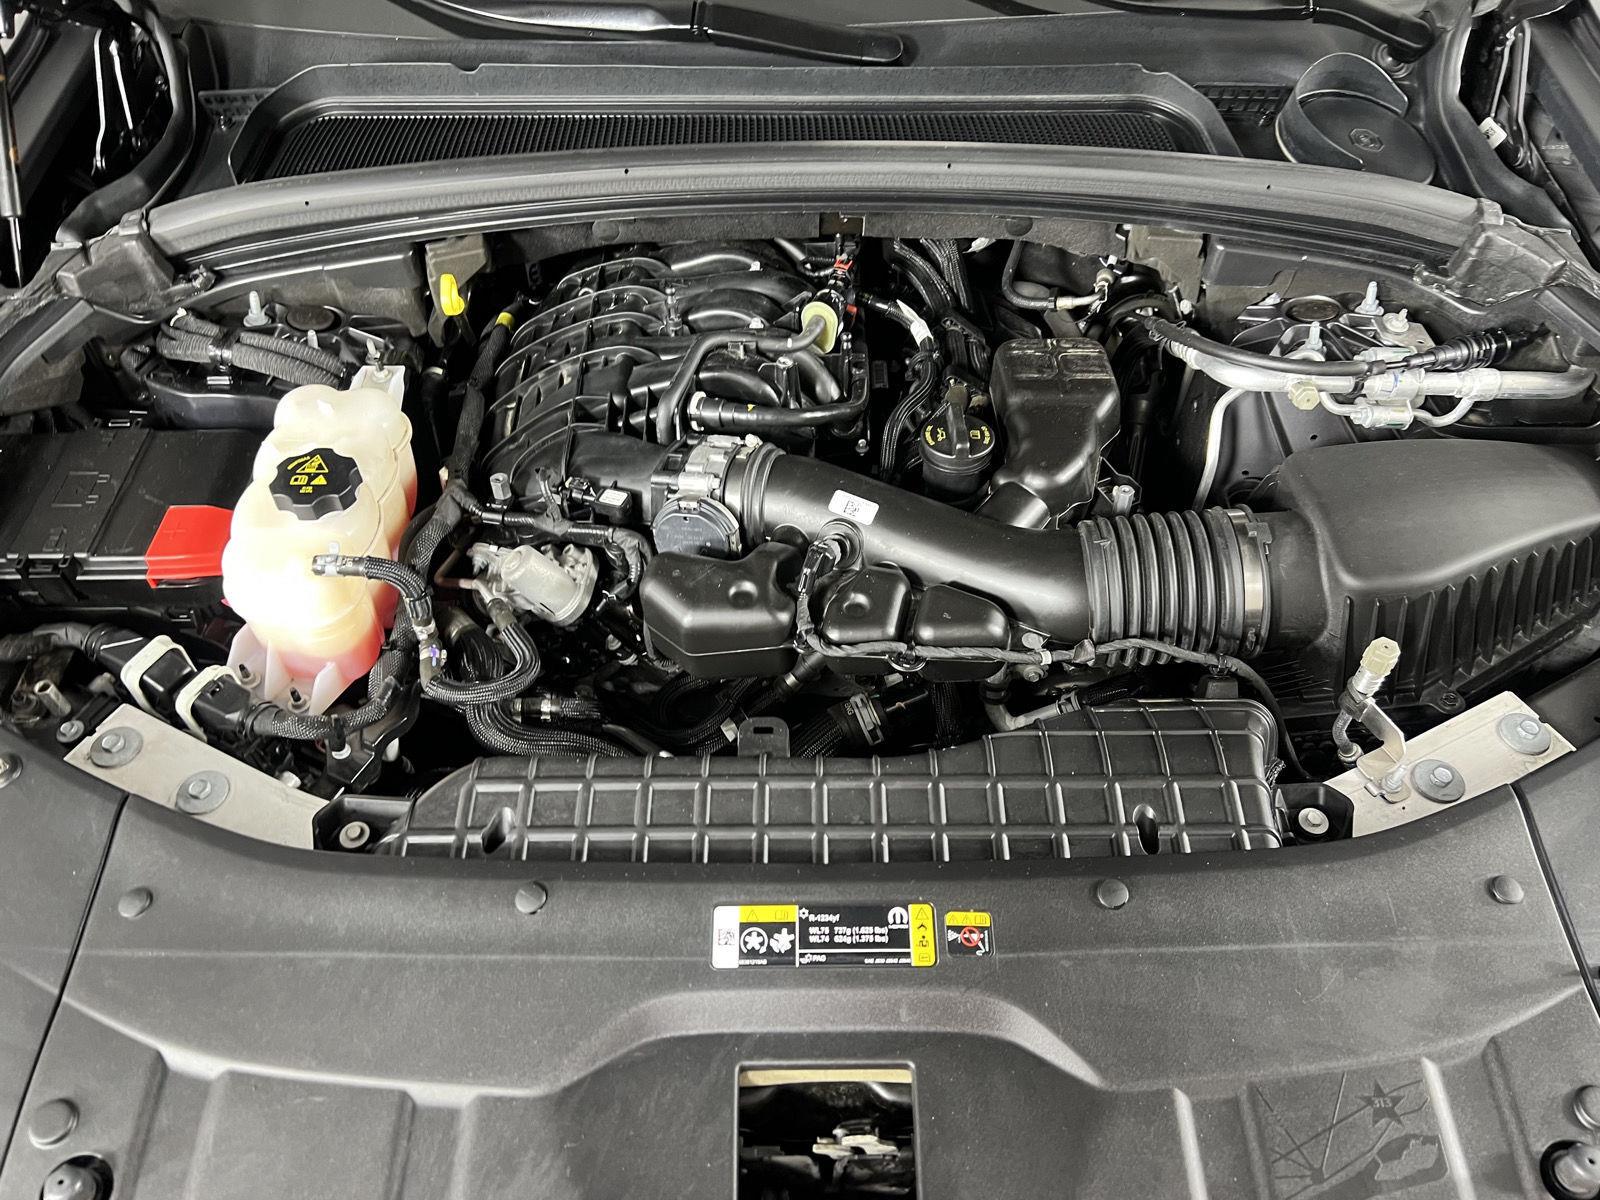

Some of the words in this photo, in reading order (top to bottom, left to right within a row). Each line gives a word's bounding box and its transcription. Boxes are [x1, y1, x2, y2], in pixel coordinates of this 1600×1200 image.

[808, 913, 840, 923] R-1234yf
[808, 926, 830, 935] WL75
[1371, 1097, 1392, 1108] 313
